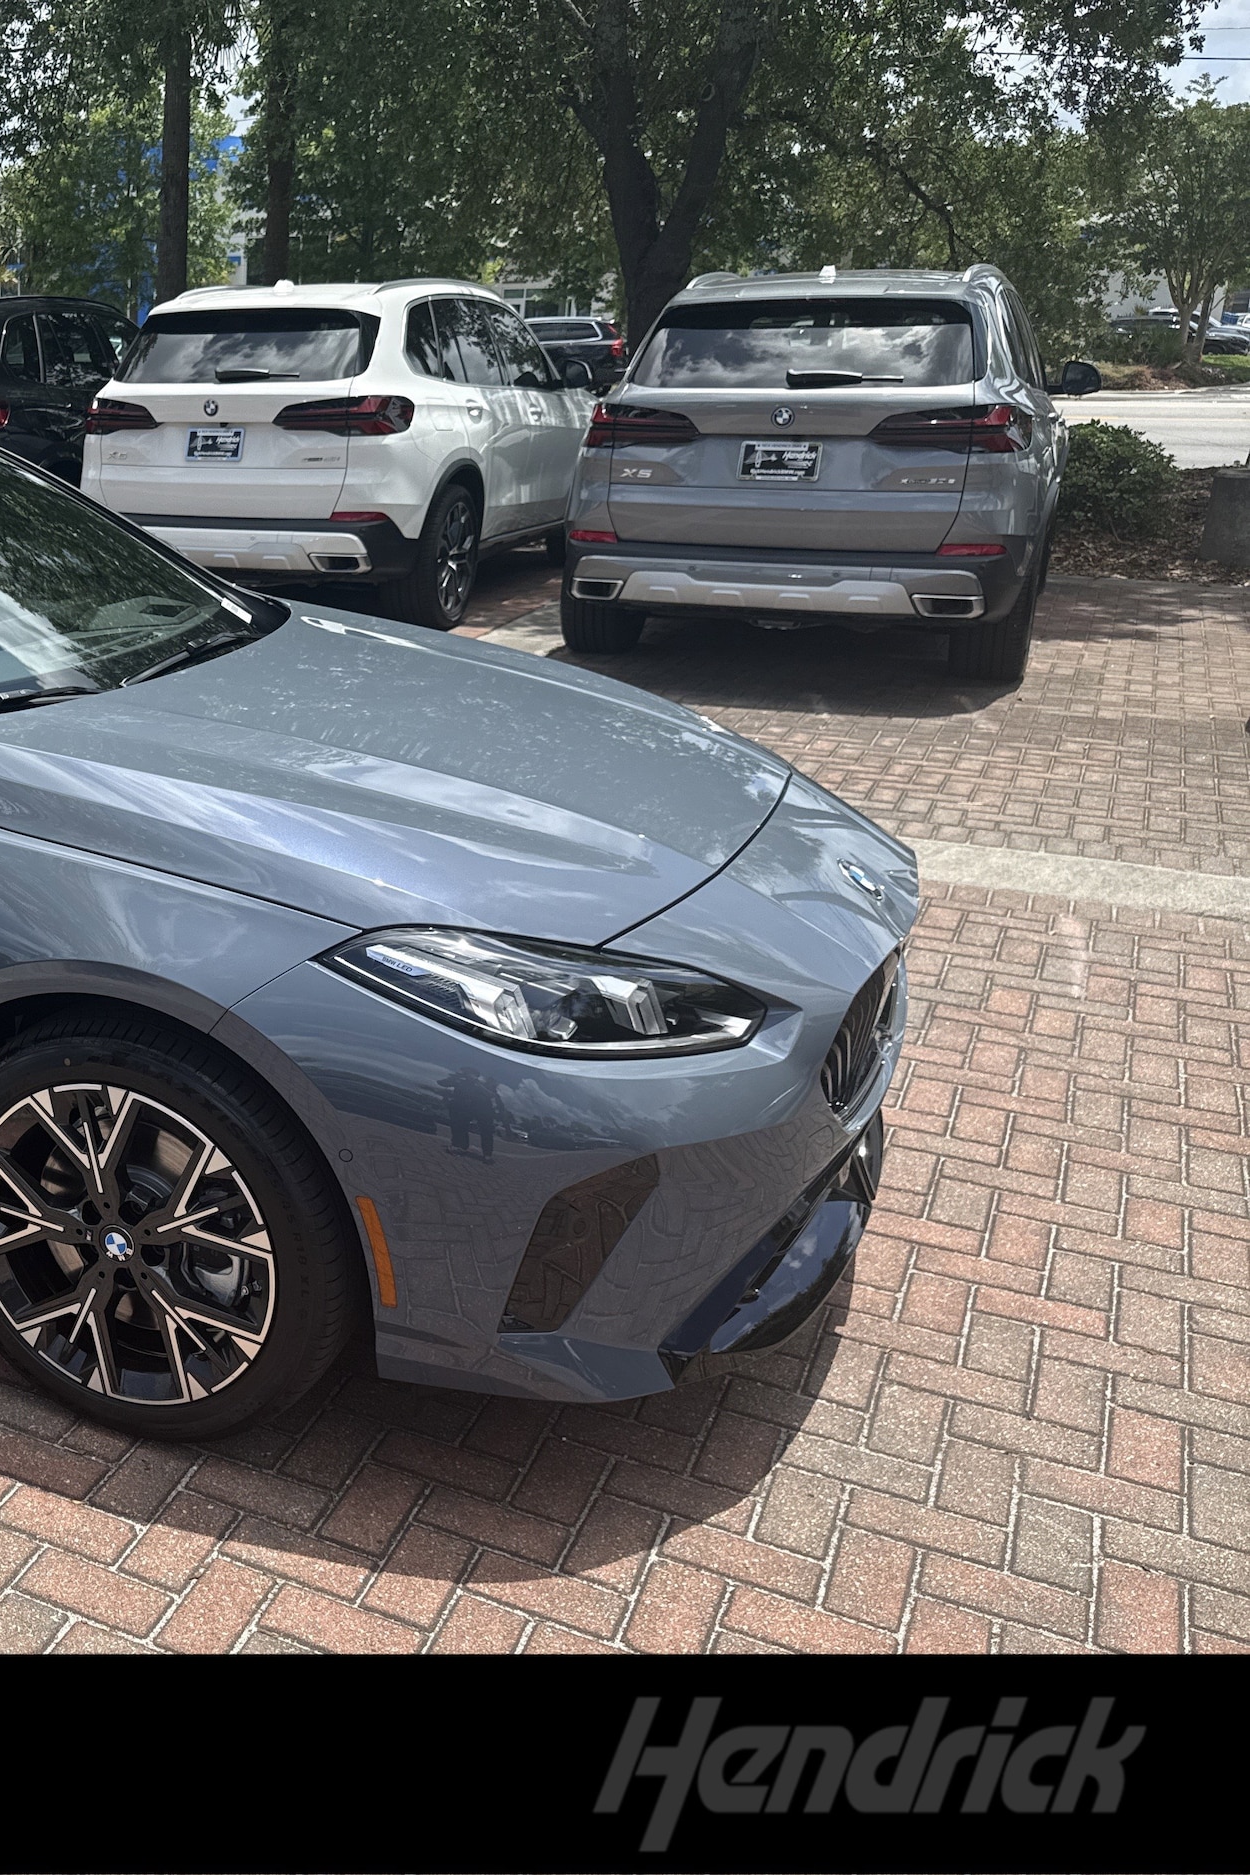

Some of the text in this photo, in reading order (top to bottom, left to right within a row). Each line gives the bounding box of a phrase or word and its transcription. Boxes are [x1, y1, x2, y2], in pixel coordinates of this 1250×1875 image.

[782, 451, 817, 461] Hendrick
[620, 468, 652, 478] X5
[382, 956, 413, 973] BMW LED
[106, 1248, 133, 1262] BMW
